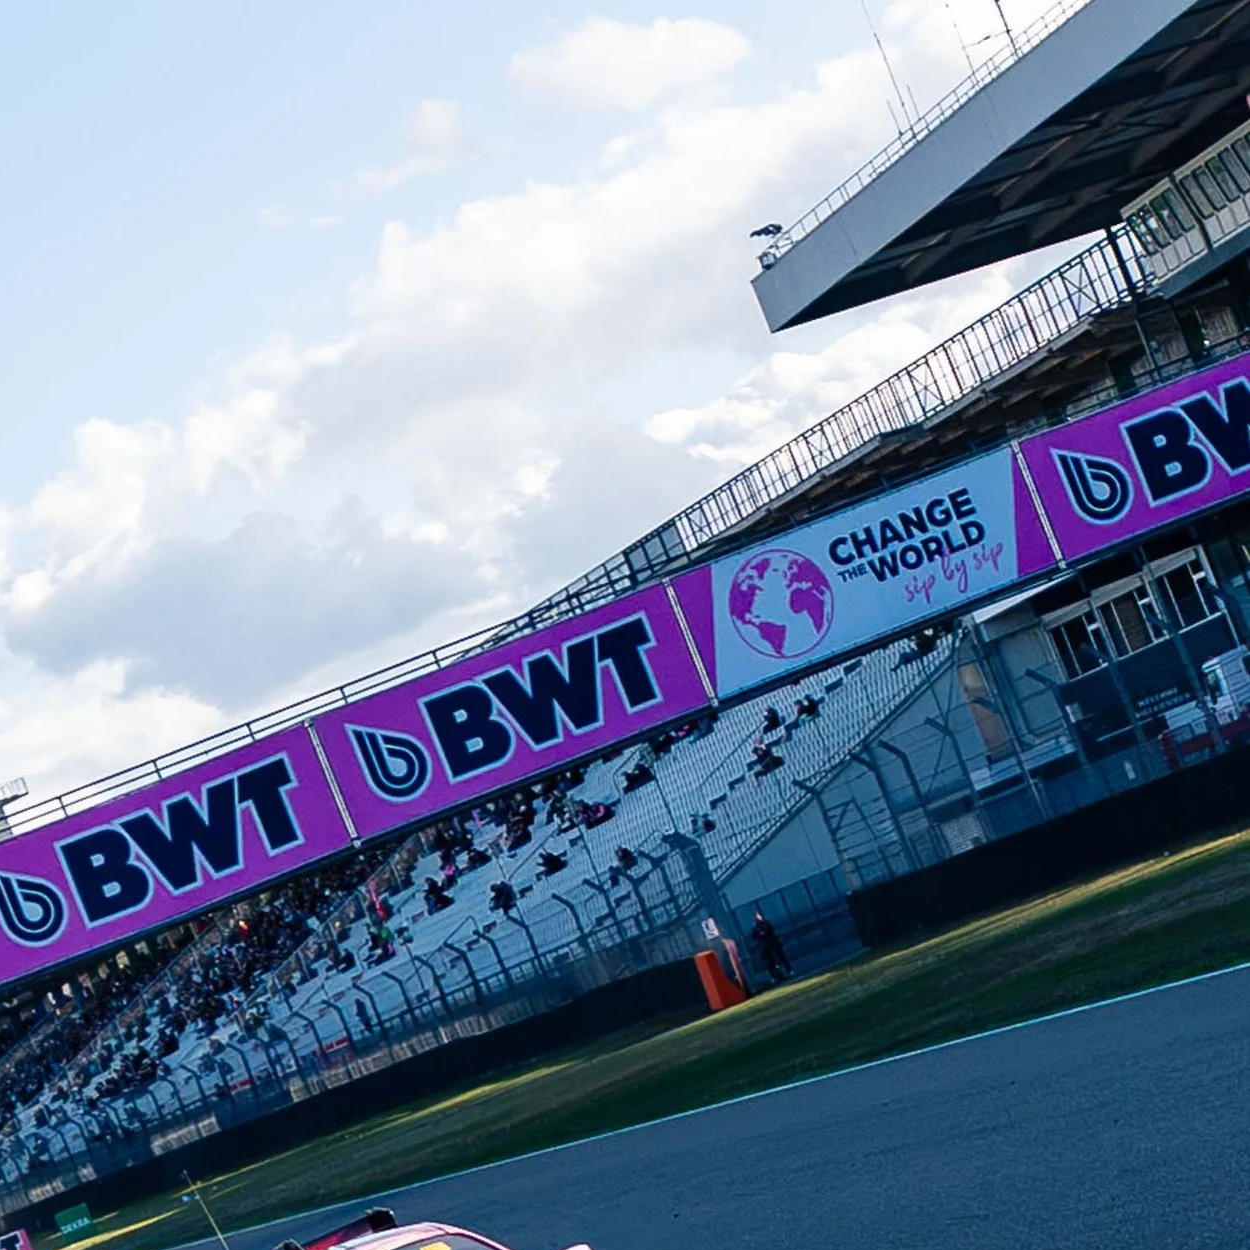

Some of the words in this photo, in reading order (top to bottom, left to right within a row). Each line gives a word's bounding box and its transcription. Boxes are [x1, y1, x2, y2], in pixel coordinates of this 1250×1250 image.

[828, 487, 977, 566] CHANGE
[837, 562, 867, 584] THE
[865, 519, 985, 584] WORLD
[903, 574, 936, 604] sip
[973, 541, 1004, 570] sip
[418, 611, 664, 784] BWT
[53, 750, 306, 930] BWT
